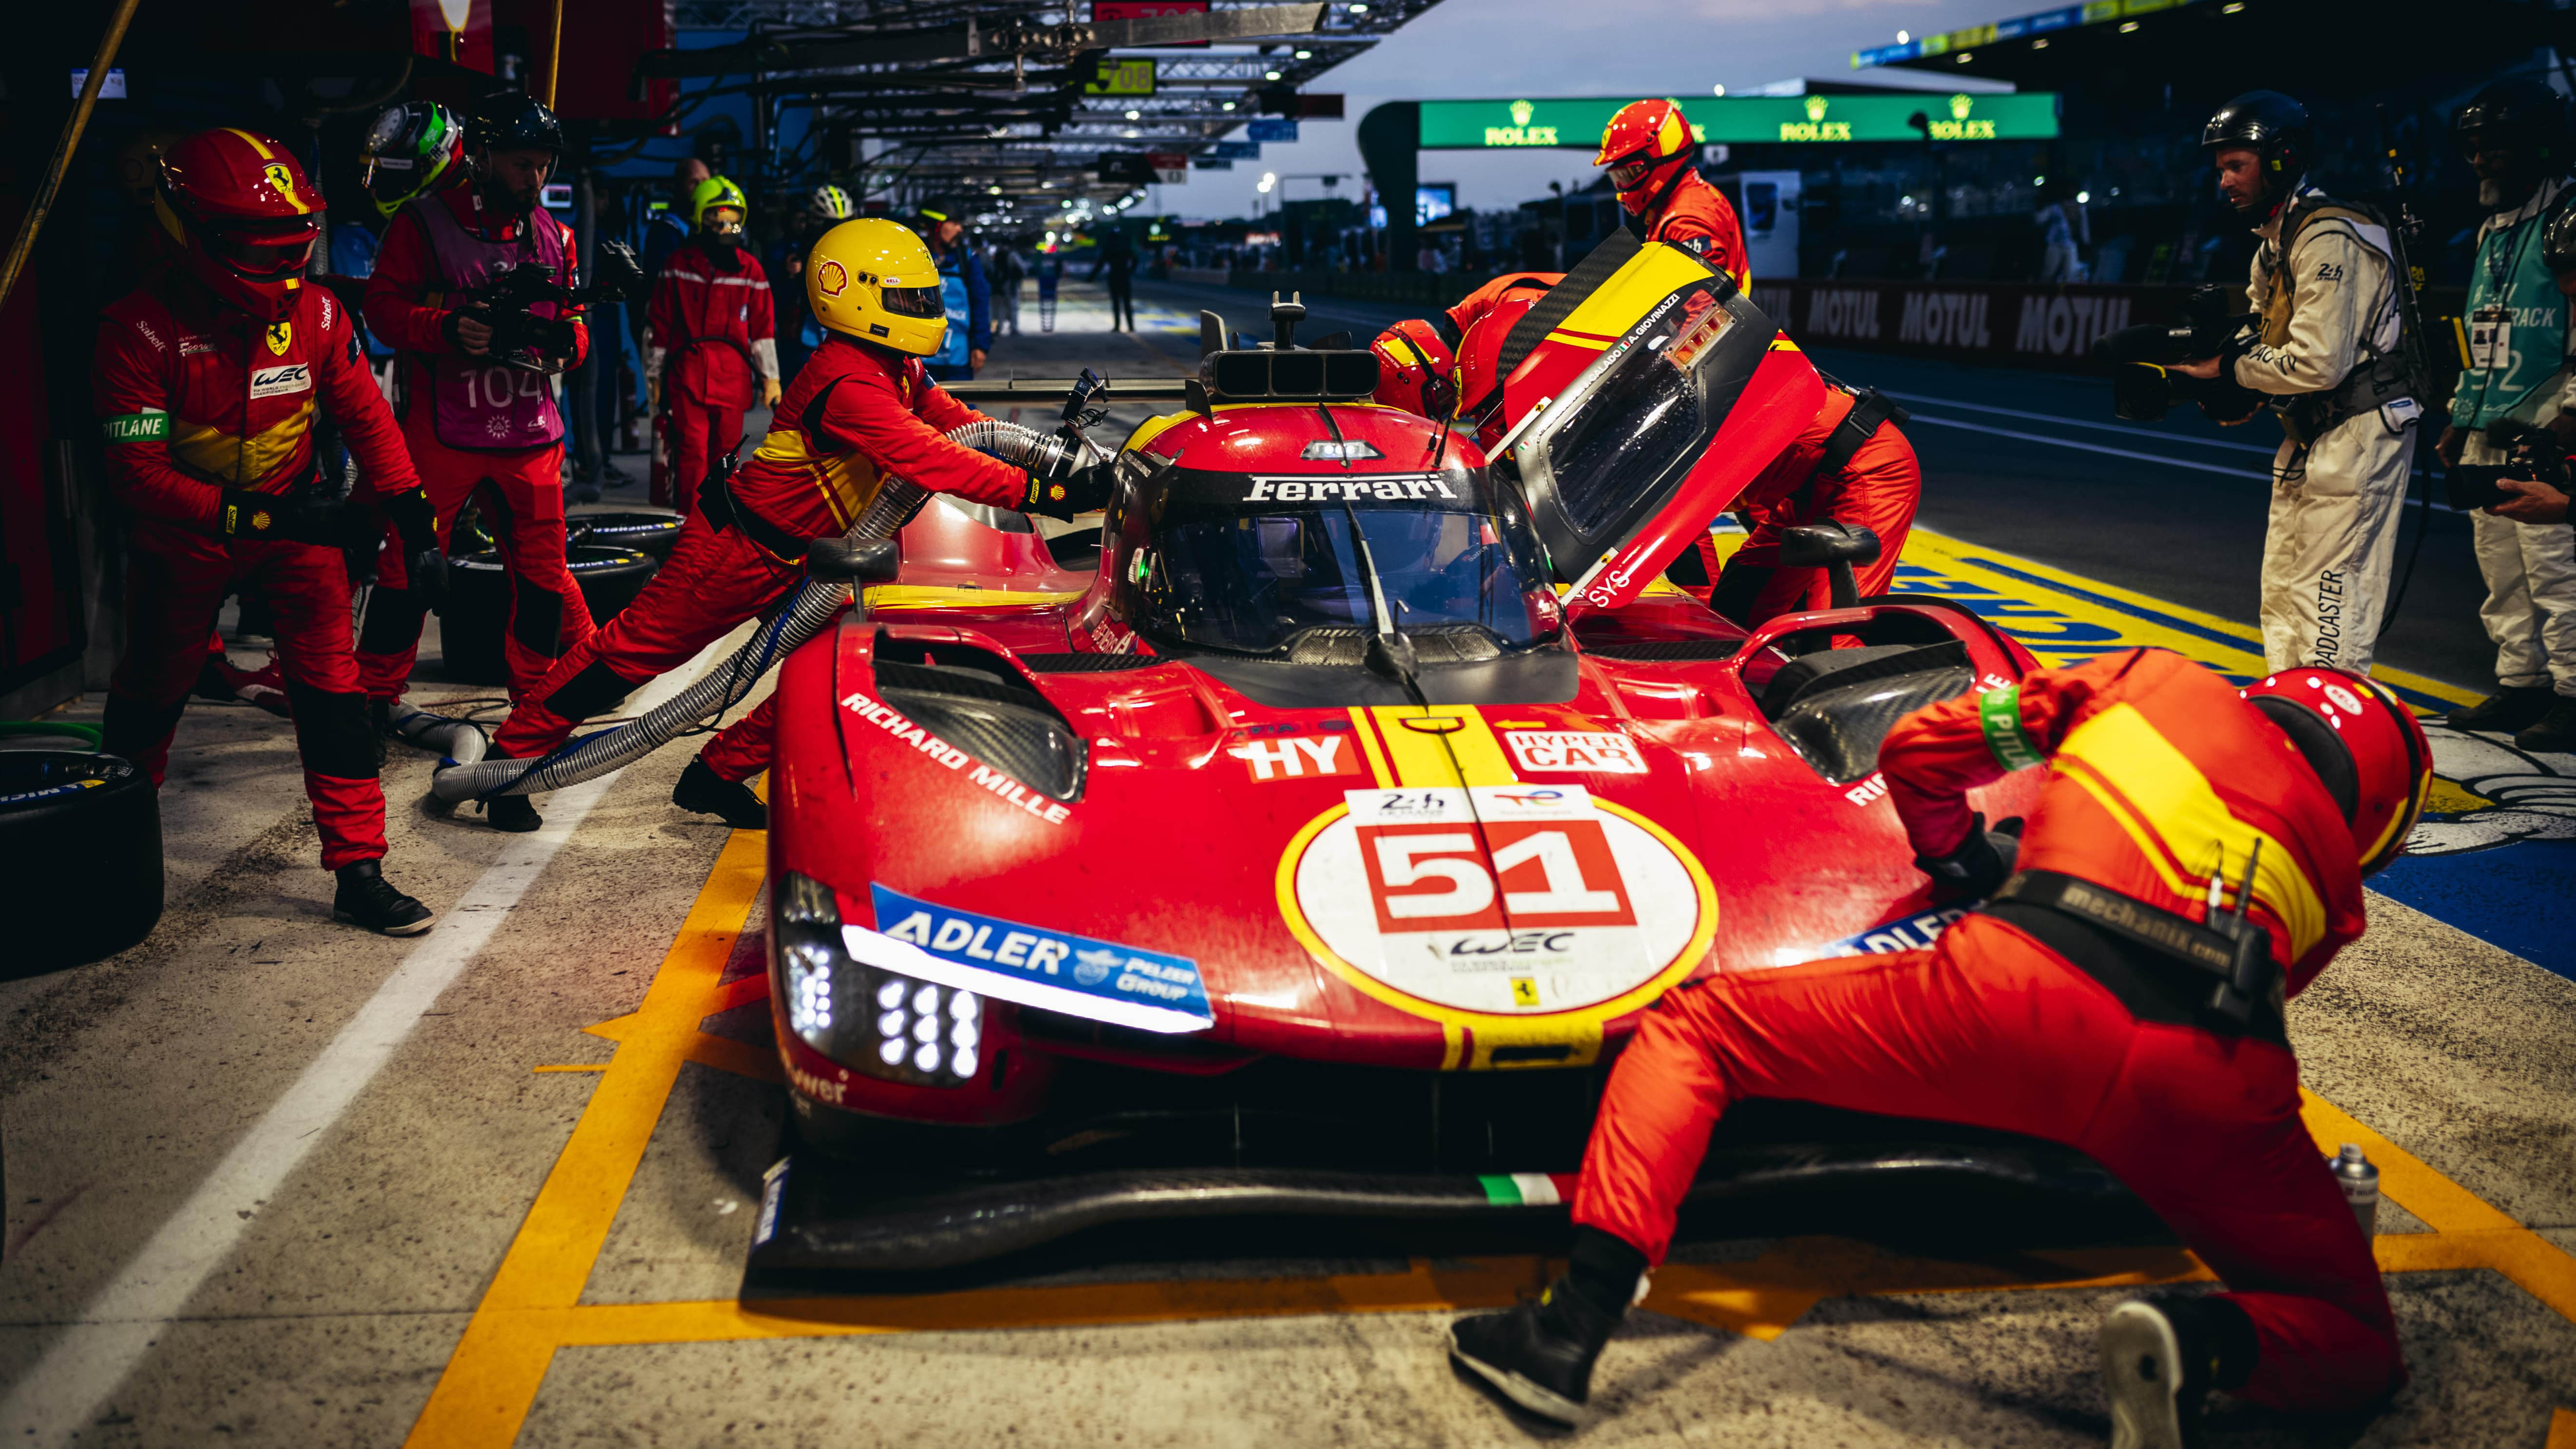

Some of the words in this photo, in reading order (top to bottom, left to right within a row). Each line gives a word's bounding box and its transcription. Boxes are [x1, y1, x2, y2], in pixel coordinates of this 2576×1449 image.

[1485, 126, 1559, 146] ROLEX
[1780, 122, 1851, 141] ROLEX
[321, 297, 332, 331] Sabelt
[1636, 293, 1680, 335] GIOVINAZZI
[1807, 290, 1881, 339] MOTUL
[1899, 292, 1993, 348] MOTUL
[2509, 307, 2557, 328] RACK
[136, 320, 168, 353] Sabelt
[254, 366, 308, 386] WEC
[1589, 349, 1622, 381] CALADO
[102, 419, 163, 438] PITLANE
[1242, 475, 1457, 501] Ferrari
[1515, 735, 1623, 747] HYPER
[840, 692, 971, 770] RICHARD
[968, 764, 1071, 825] MILLE
[1247, 735, 1341, 780] HY
[1524, 747, 1637, 768] CAR
[1374, 830, 1622, 919] 51
[884, 911, 1070, 975] ADLER
[1450, 932, 1575, 954] WEC
[1116, 973, 1188, 1001] GROUP
